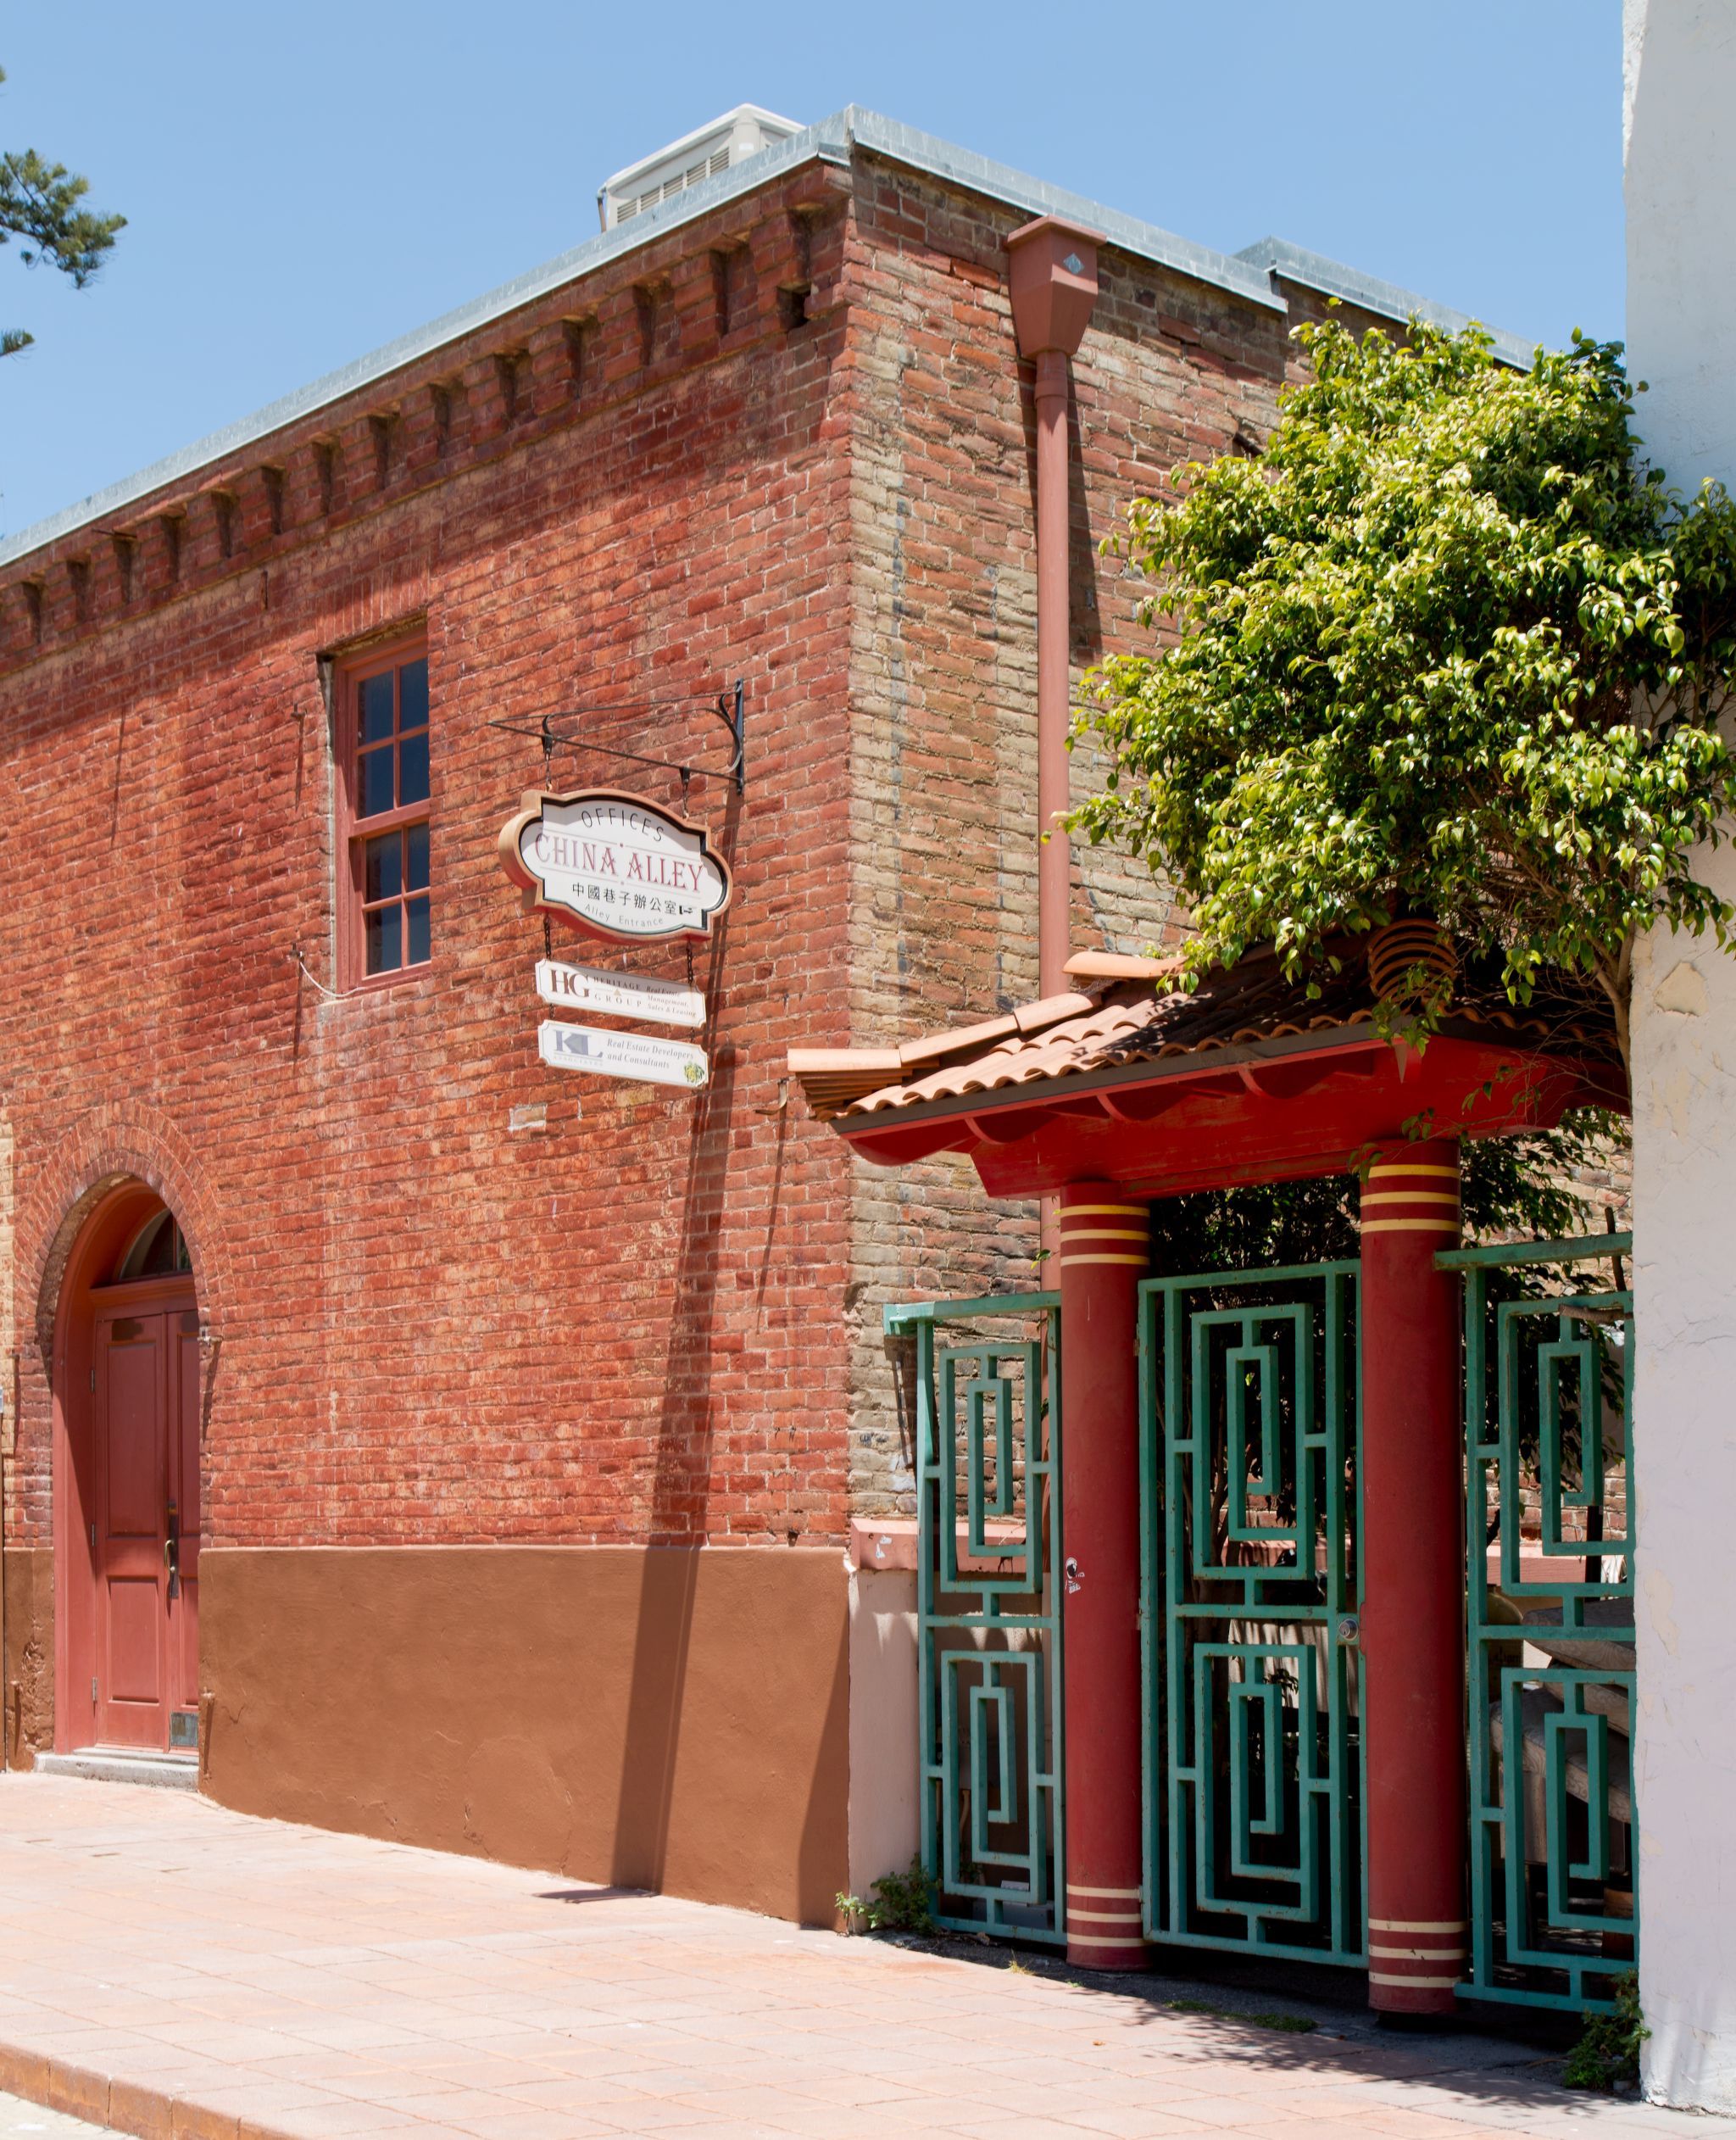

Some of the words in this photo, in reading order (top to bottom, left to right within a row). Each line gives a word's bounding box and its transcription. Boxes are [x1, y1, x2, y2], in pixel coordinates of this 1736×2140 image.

[581, 807, 665, 843] OFFICES
[535, 833, 618, 877] CHINA
[626, 850, 705, 894] ALLEY
[572, 882, 677, 916] 中國巷子辦公室
[585, 903, 610, 922] Alley
[619, 915, 664, 928] Entrance
[550, 969, 590, 998] HG
[593, 976, 641, 991] HERITAGE
[646, 985, 660, 994] Real
[662, 987, 679, 996] Estate
[594, 993, 642, 1007] GROUP
[647, 1003, 664, 1011] Sales
[672, 1007, 697, 1018] Leasing
[607, 1038, 625, 1047] Real
[626, 1040, 650, 1052] Estate
[652, 1045, 694, 1060] Developers
[607, 1053, 622, 1062] and
[624, 1054, 670, 1068] Consultants
